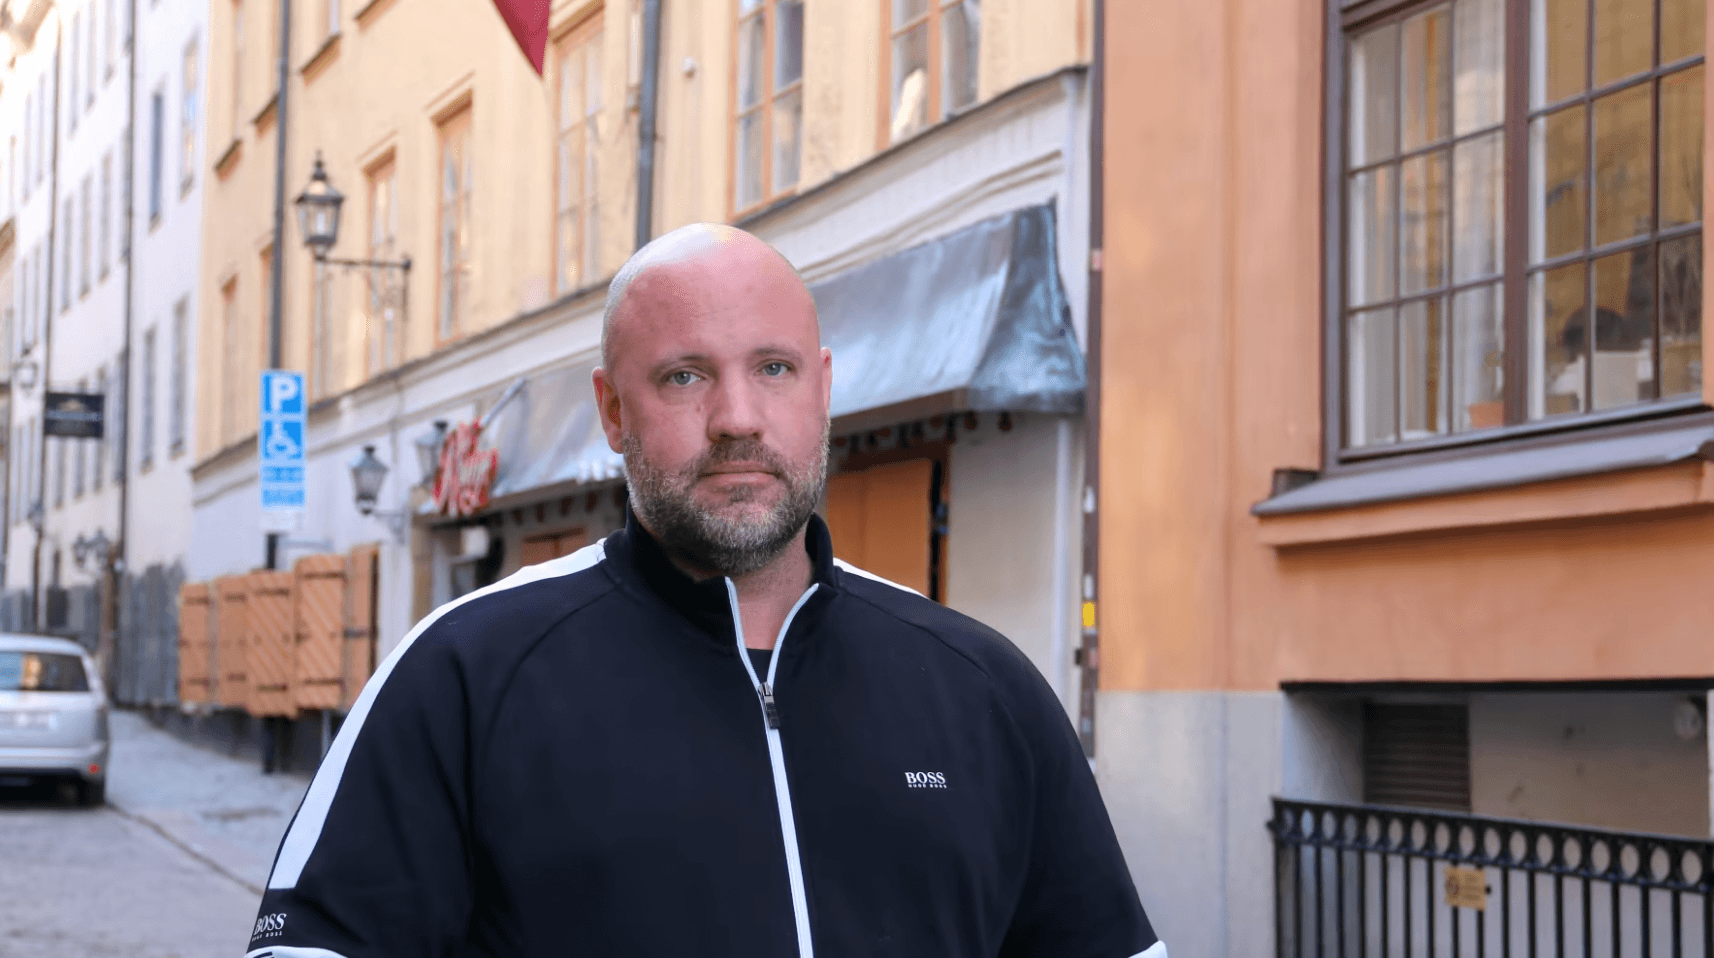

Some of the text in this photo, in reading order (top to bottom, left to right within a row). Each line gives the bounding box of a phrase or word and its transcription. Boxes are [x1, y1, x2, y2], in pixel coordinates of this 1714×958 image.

[272, 376, 297, 411] P
[904, 771, 946, 784] BOSS
[253, 913, 287, 935] BOSS
